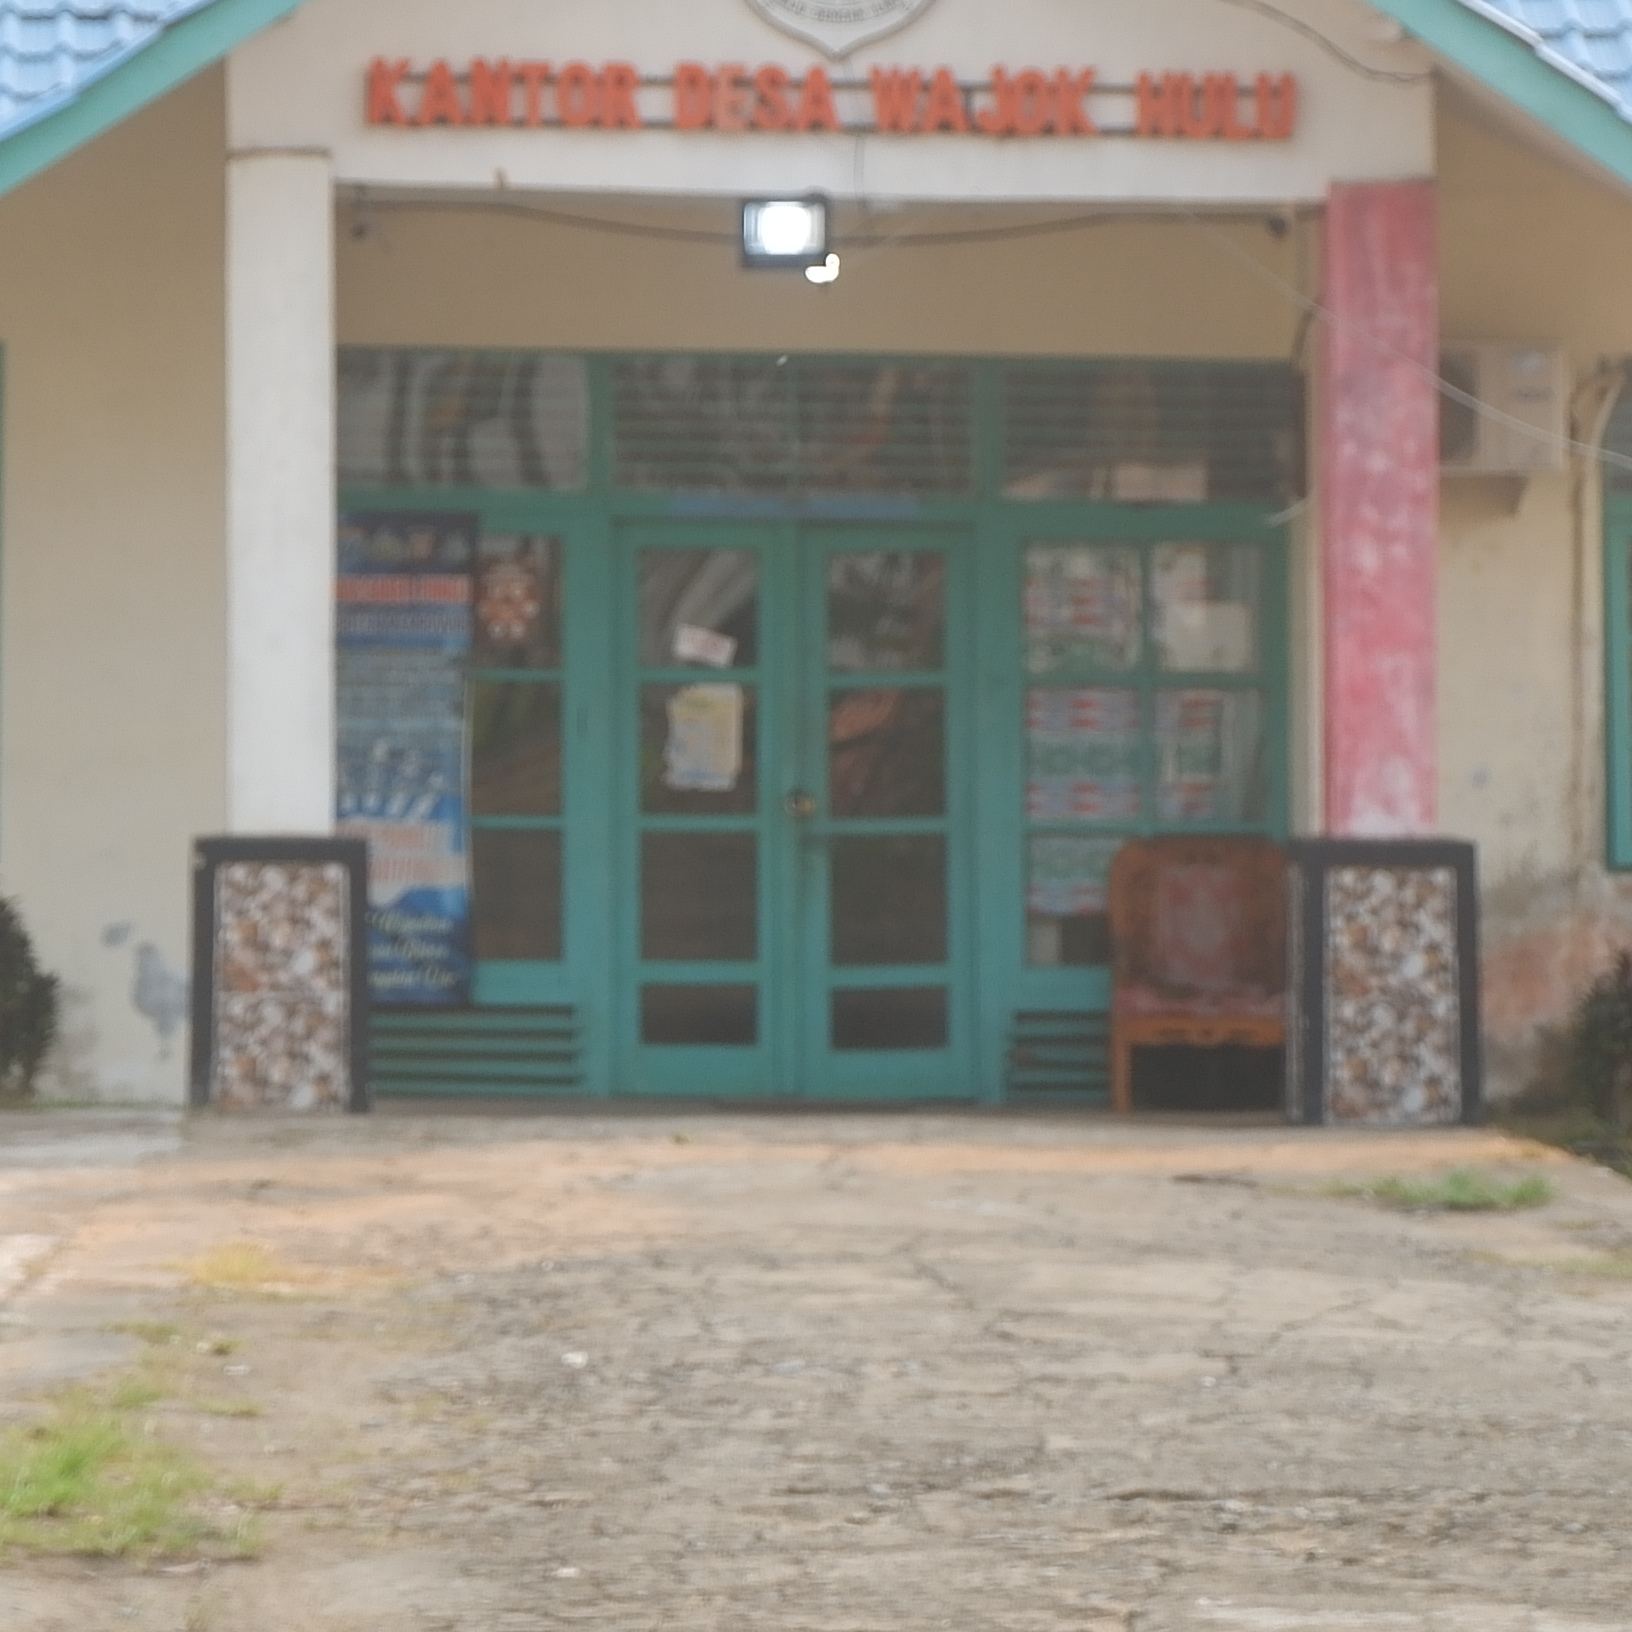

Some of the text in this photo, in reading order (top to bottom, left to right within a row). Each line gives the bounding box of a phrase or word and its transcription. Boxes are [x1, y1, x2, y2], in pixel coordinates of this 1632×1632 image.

[365, 57, 1296, 142] KANTOR DESA WAJOK HULU
